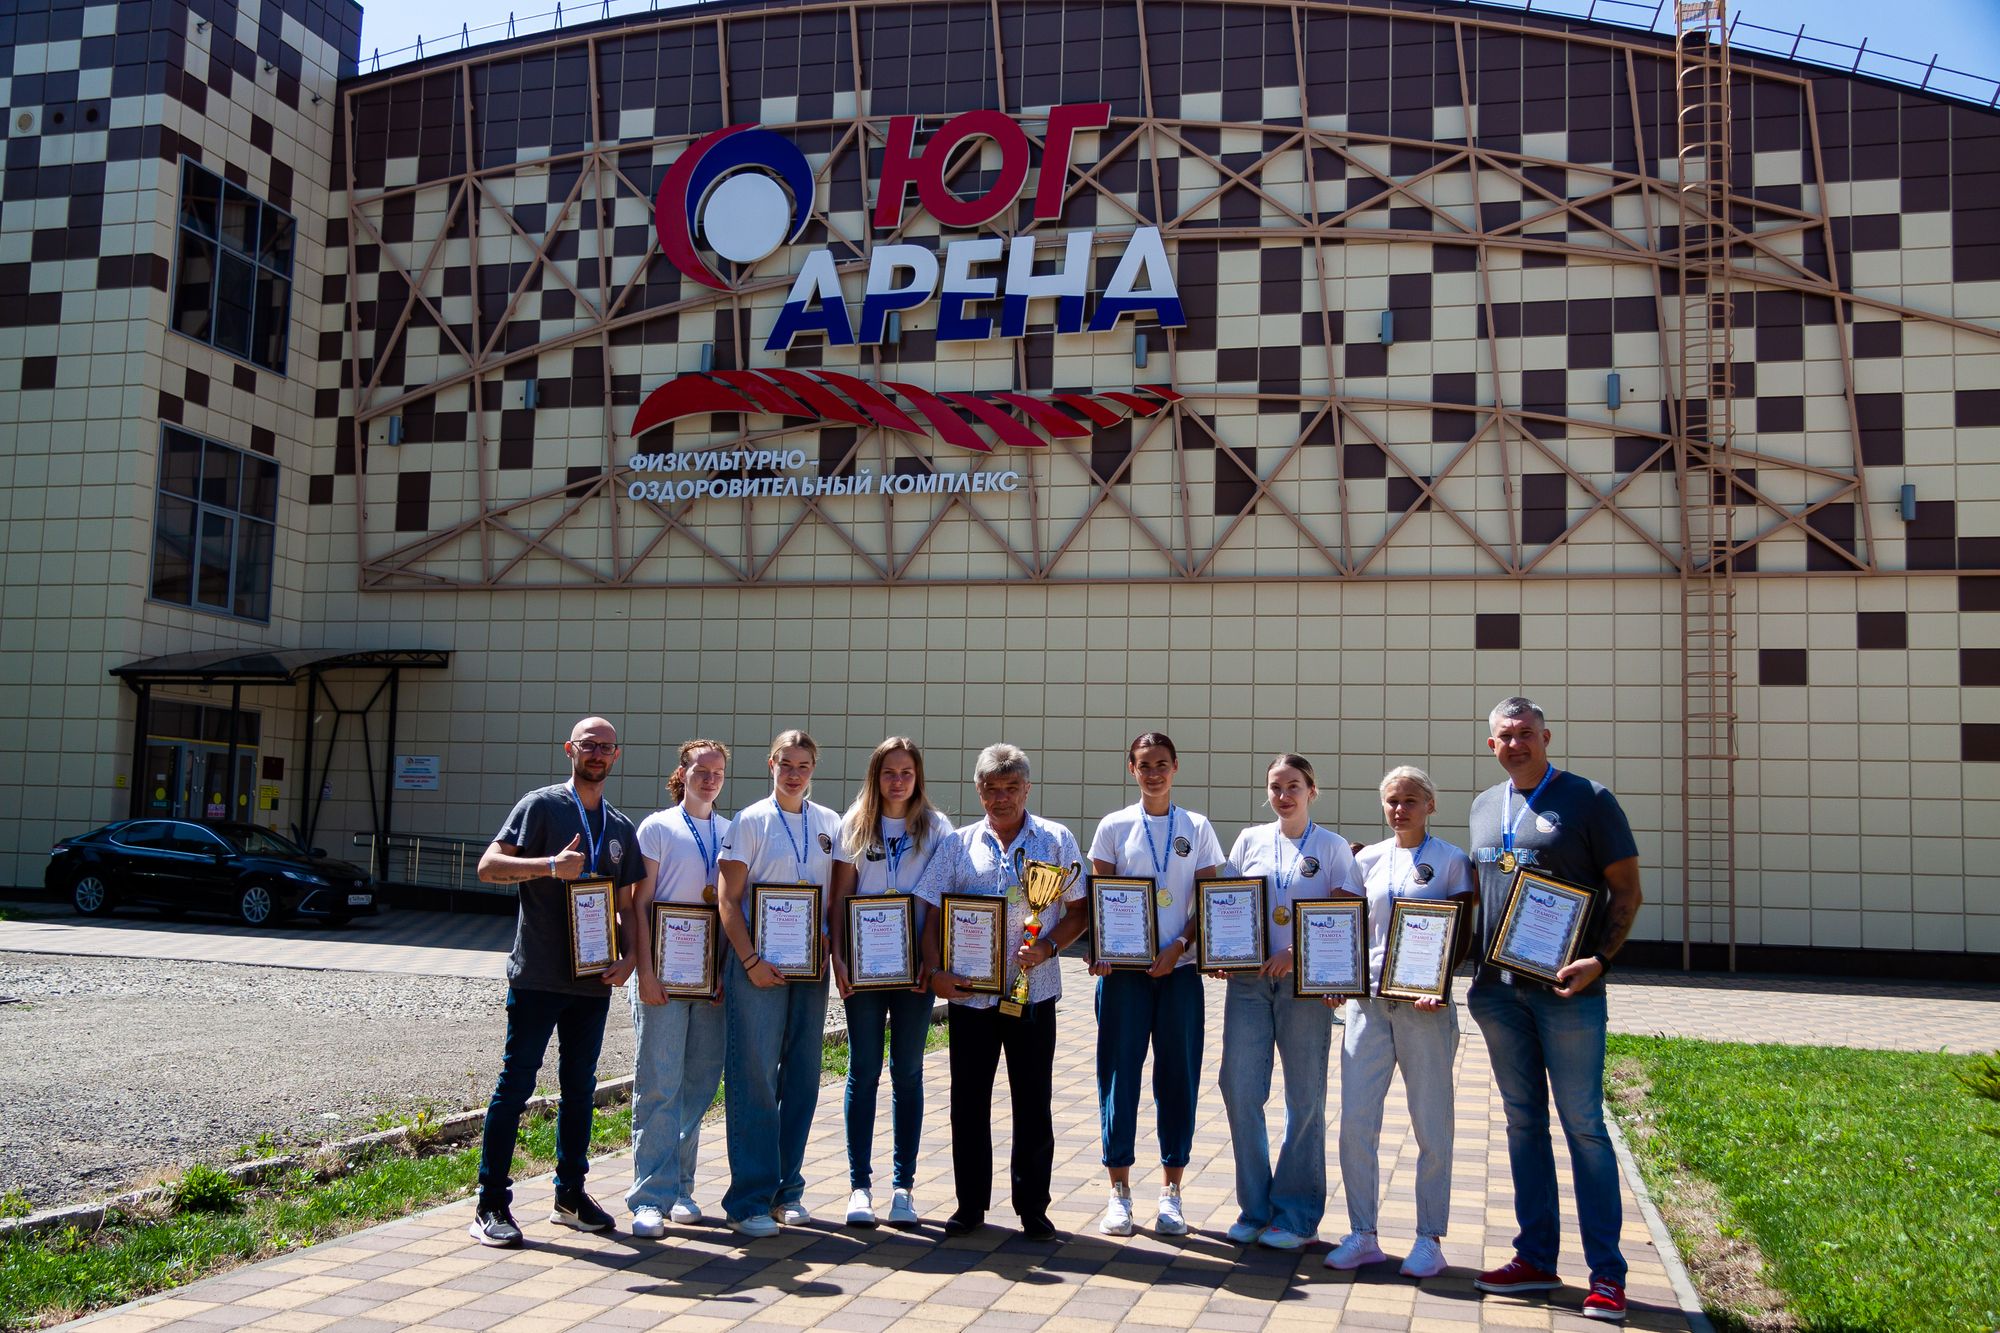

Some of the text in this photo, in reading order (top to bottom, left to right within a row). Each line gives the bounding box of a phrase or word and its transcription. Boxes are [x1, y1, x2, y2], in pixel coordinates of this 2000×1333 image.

[873, 103, 1111, 229] ЮГ
[763, 226, 1187, 352] АРЕНА
[628, 469, 1019, 503] ОЗДОРОВИТЕЛЬНЫЙ КОМПЛЕКС
